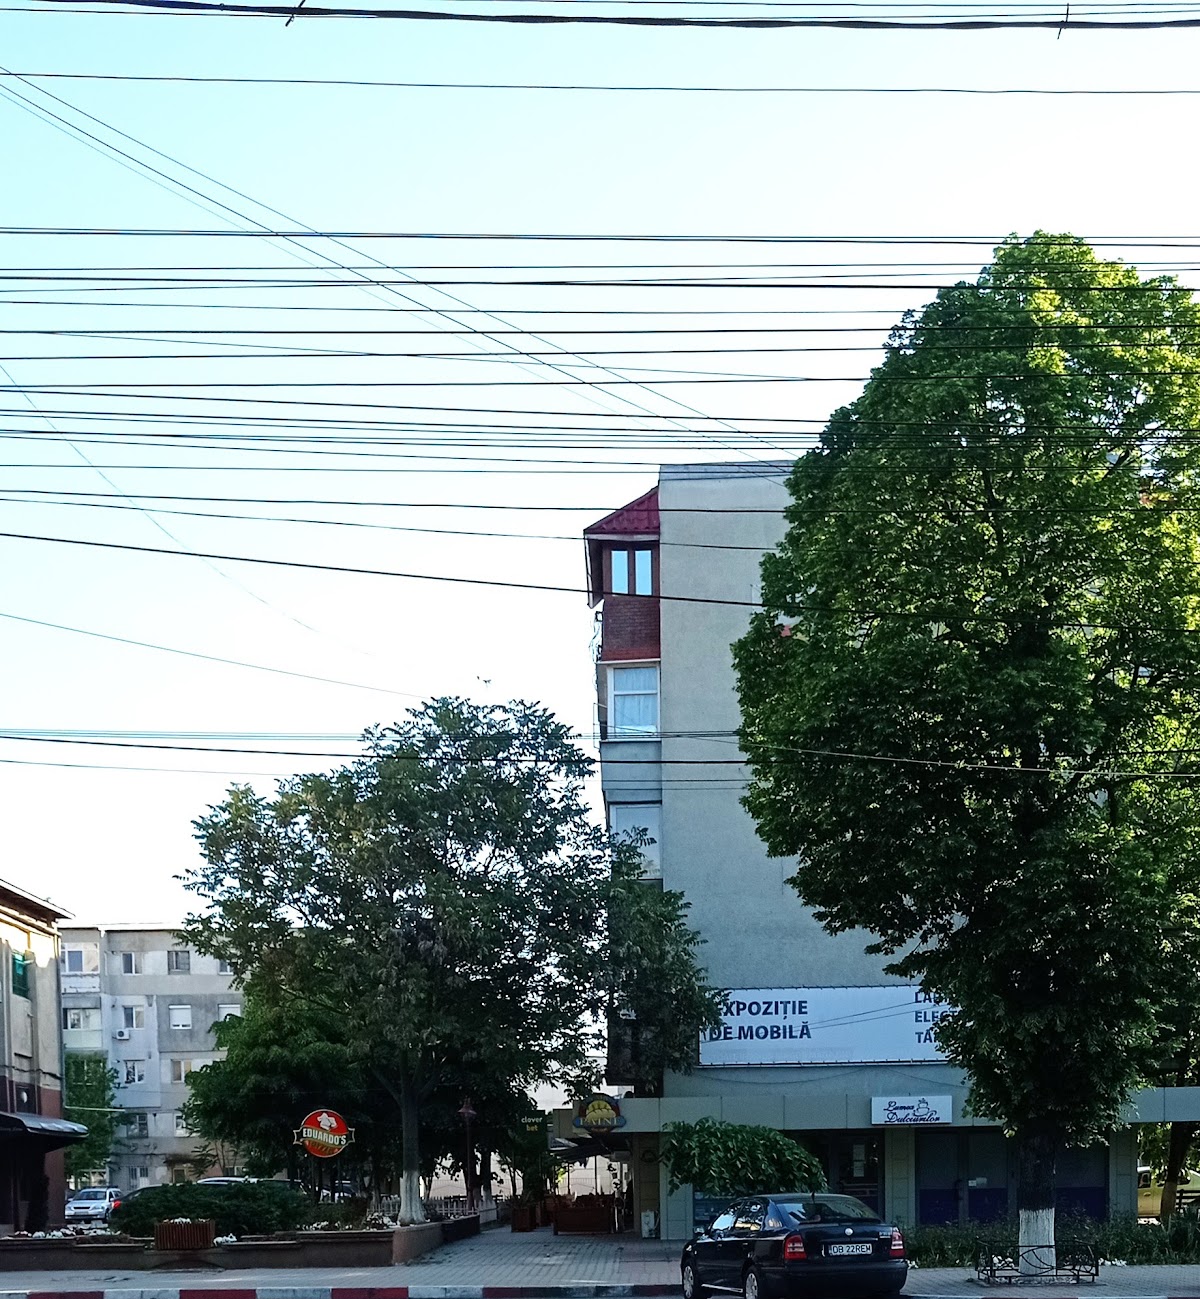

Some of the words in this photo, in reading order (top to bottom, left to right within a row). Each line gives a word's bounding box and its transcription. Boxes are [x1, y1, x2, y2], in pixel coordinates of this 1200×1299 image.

[709, 1025, 733, 1041] DE
[738, 1021, 812, 1040] MOBILĂ
[302, 1128, 347, 1146] EDUARDO'S
[526, 1124, 538, 1132] bet
